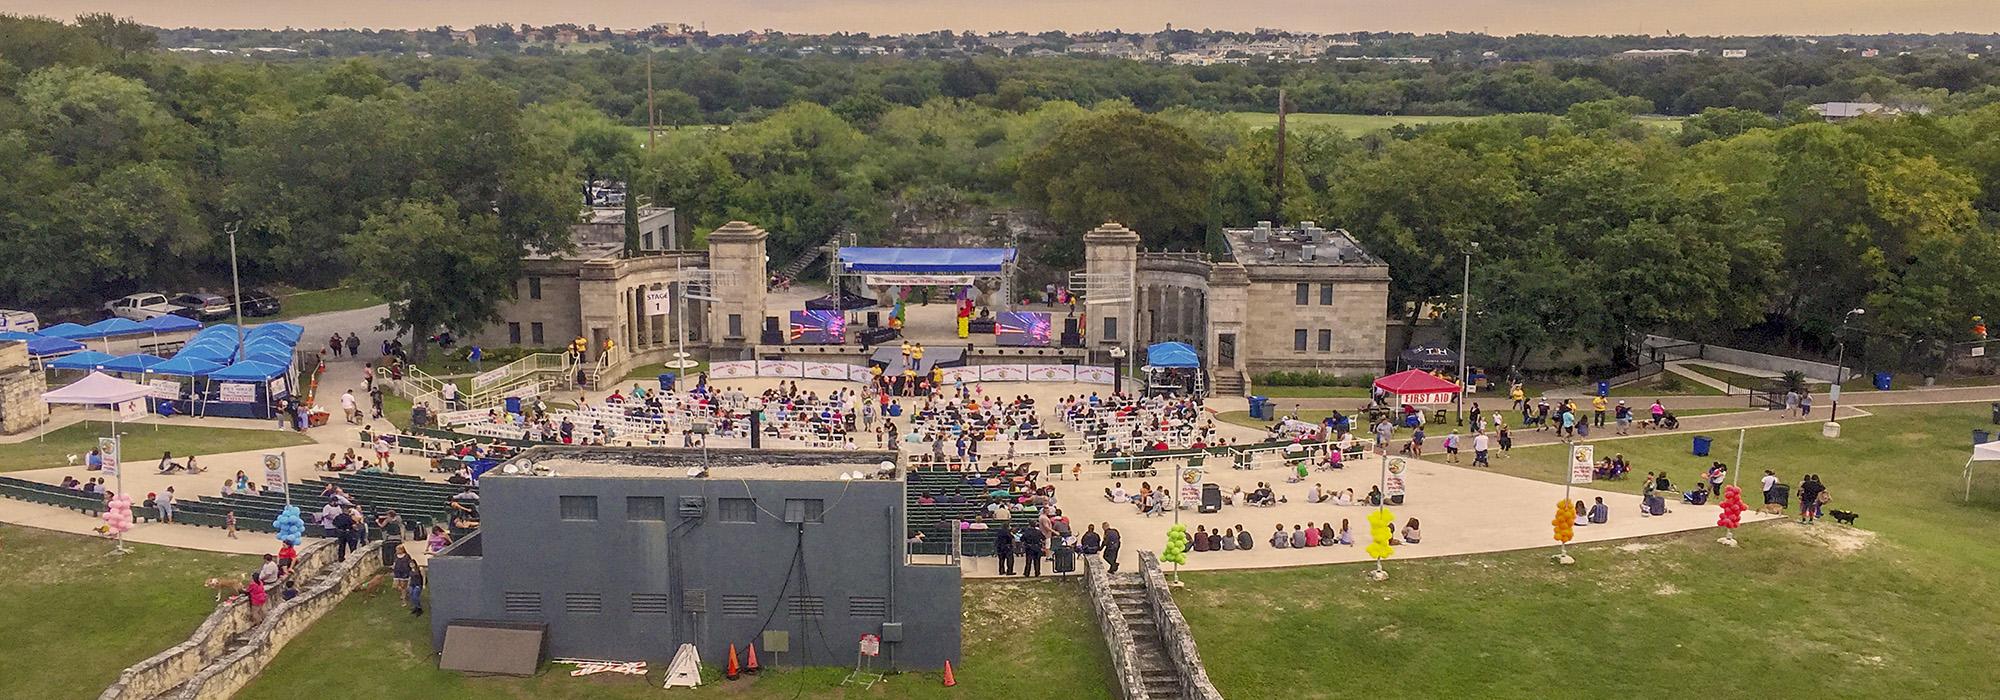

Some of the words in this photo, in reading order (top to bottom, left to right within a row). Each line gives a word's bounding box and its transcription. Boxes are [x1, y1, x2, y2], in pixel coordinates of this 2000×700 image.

[647, 293, 667, 301] STAGE
[655, 302, 660, 311] 1
[1405, 393, 1430, 403] FIRST
[1434, 393, 1449, 403] AID
